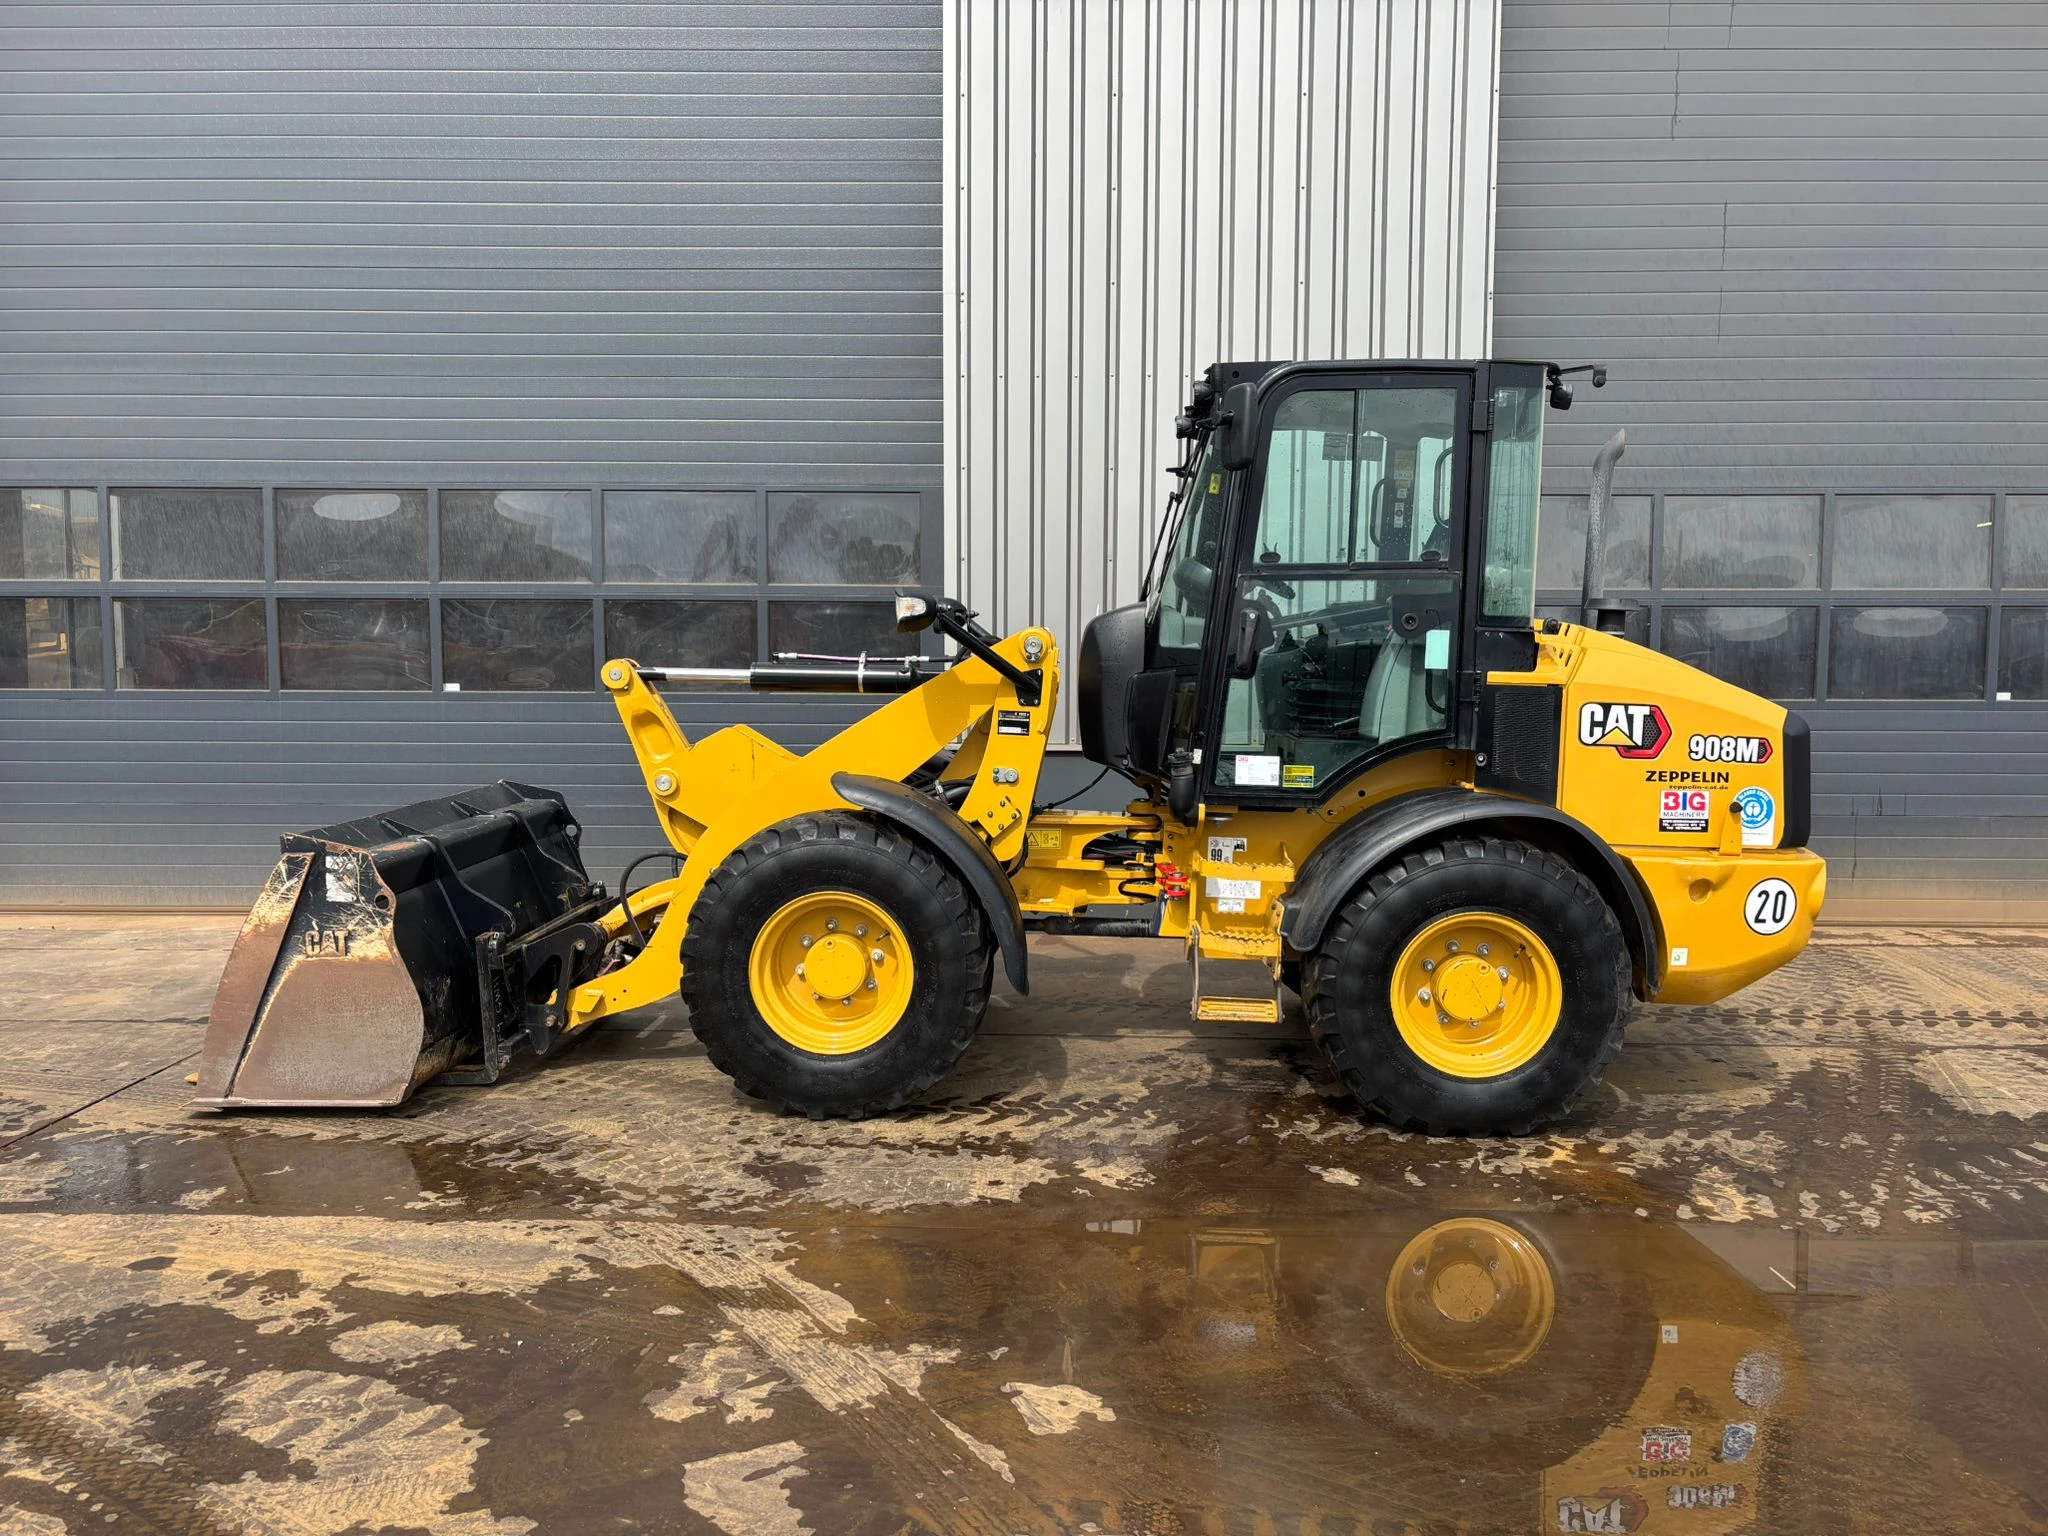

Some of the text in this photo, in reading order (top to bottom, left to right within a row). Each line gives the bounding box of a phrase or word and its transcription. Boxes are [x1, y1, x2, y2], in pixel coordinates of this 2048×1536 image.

[1580, 702, 1651, 747] CAT
[1689, 735, 1760, 763] 908M
[1645, 770, 1730, 783] ZEPPELIN
[1210, 848, 1223, 862] 99
[1754, 889, 1787, 924] 20
[305, 930, 349, 957] CAT
